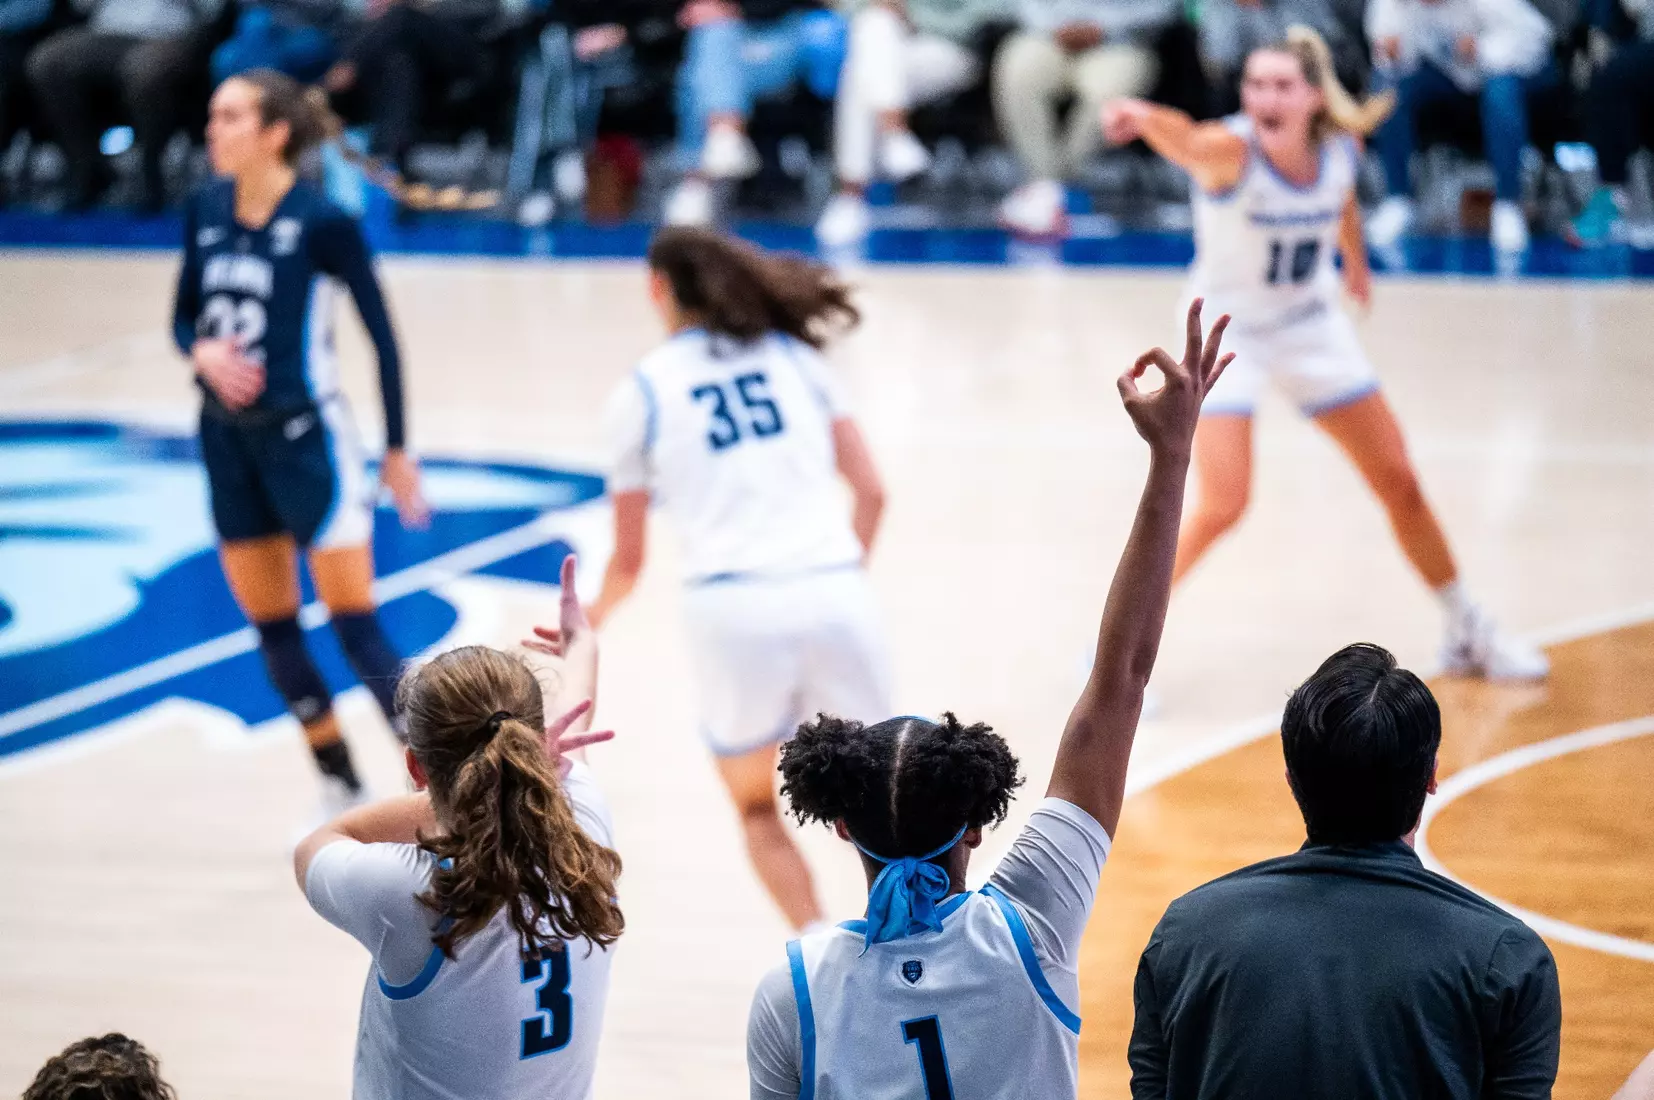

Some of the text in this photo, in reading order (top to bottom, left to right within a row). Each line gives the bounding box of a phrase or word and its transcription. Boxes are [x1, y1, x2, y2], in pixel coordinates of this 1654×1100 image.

[690, 370, 784, 451] 35
[520, 940, 573, 1060] 3
[901, 1015, 955, 1100] 1
